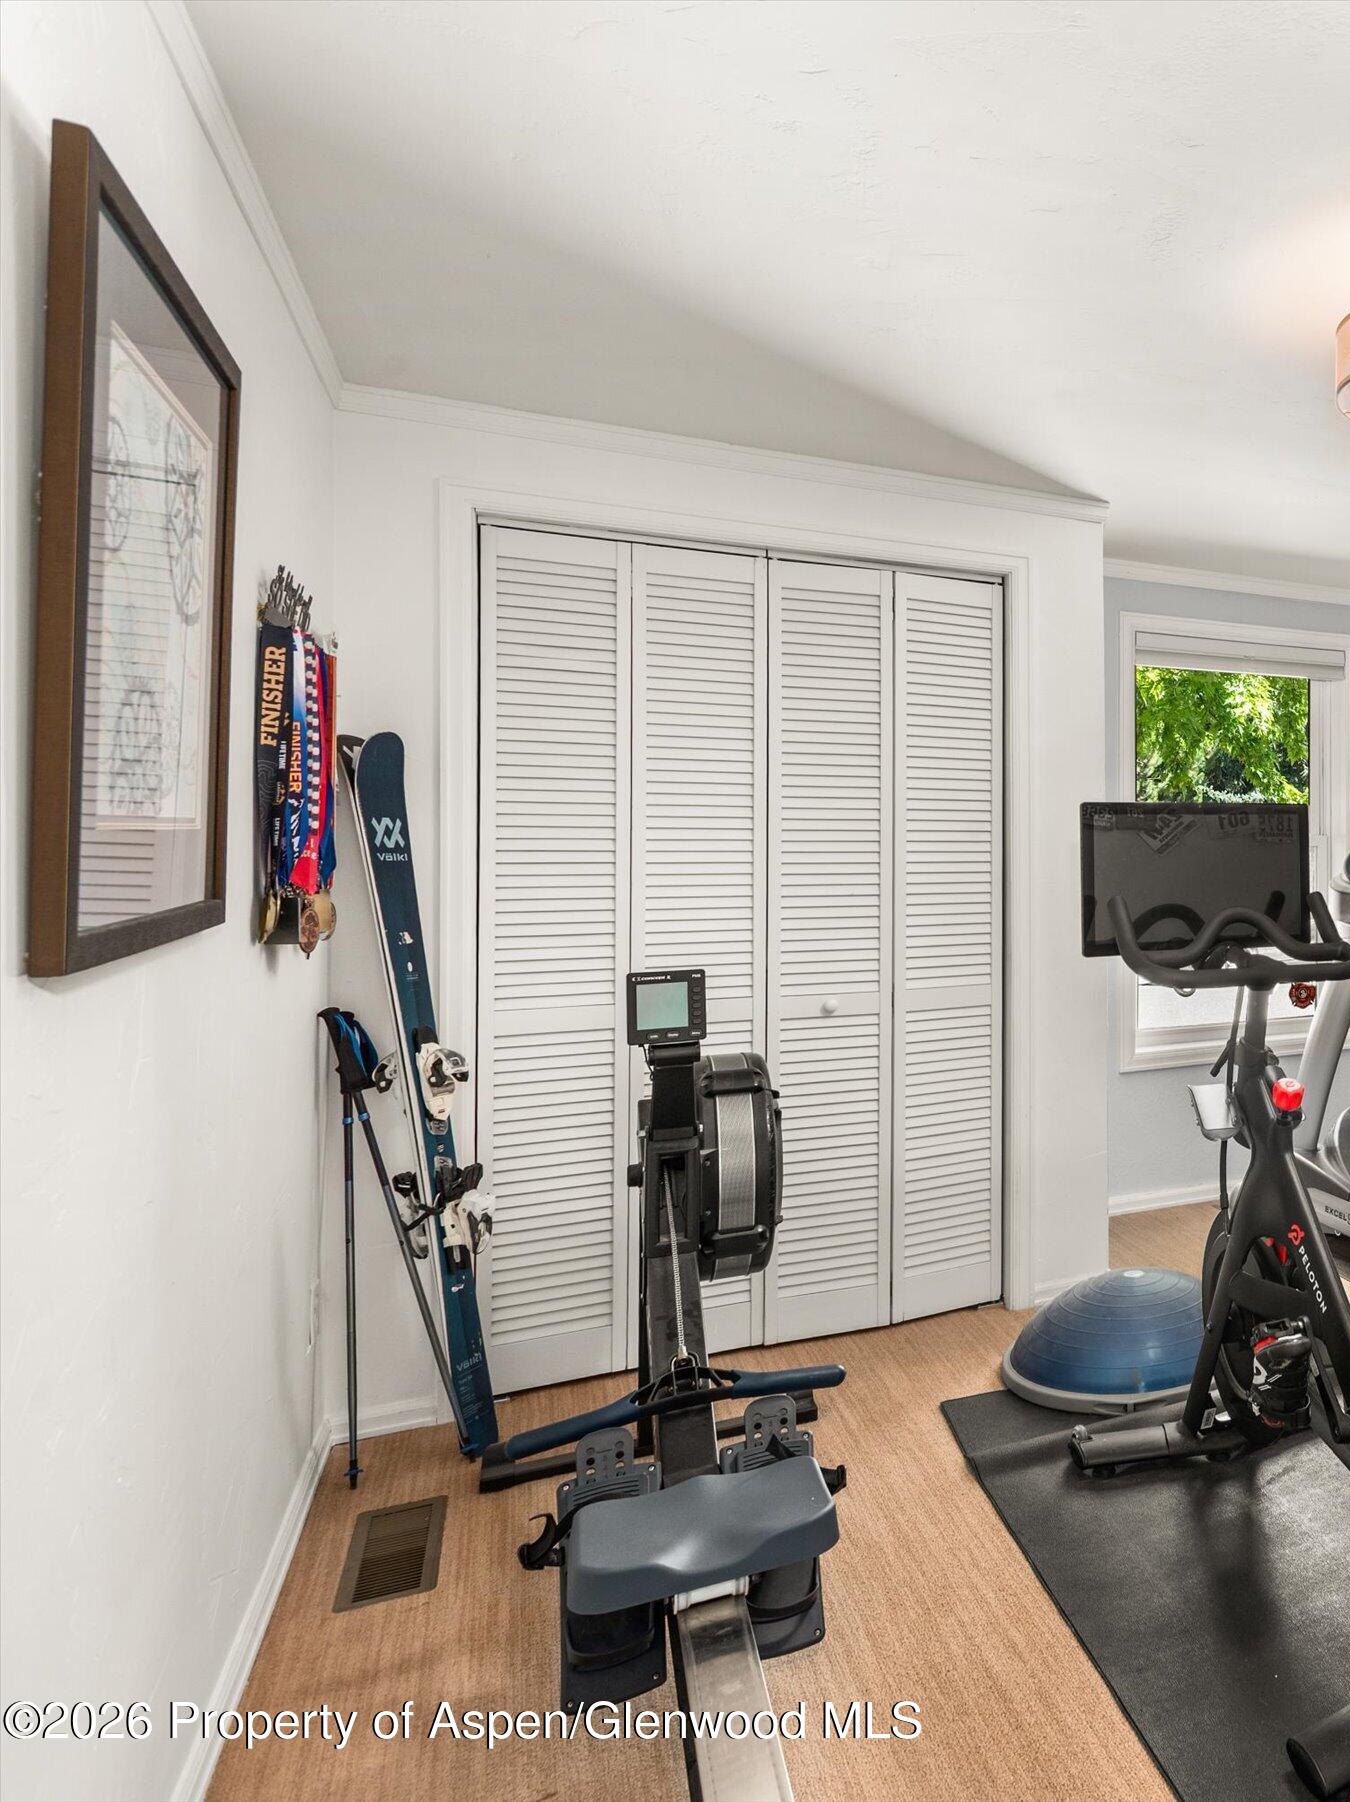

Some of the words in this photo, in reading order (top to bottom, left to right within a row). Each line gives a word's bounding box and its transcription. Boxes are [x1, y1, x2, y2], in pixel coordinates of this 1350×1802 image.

[260, 646, 287, 747] FINISHER
[289, 721, 302, 792] FINISHER
[377, 853, 409, 862] Völkl
[1324, 1205, 1348, 1222] EXCEL
[1298, 1245, 1328, 1313] PELOTON
